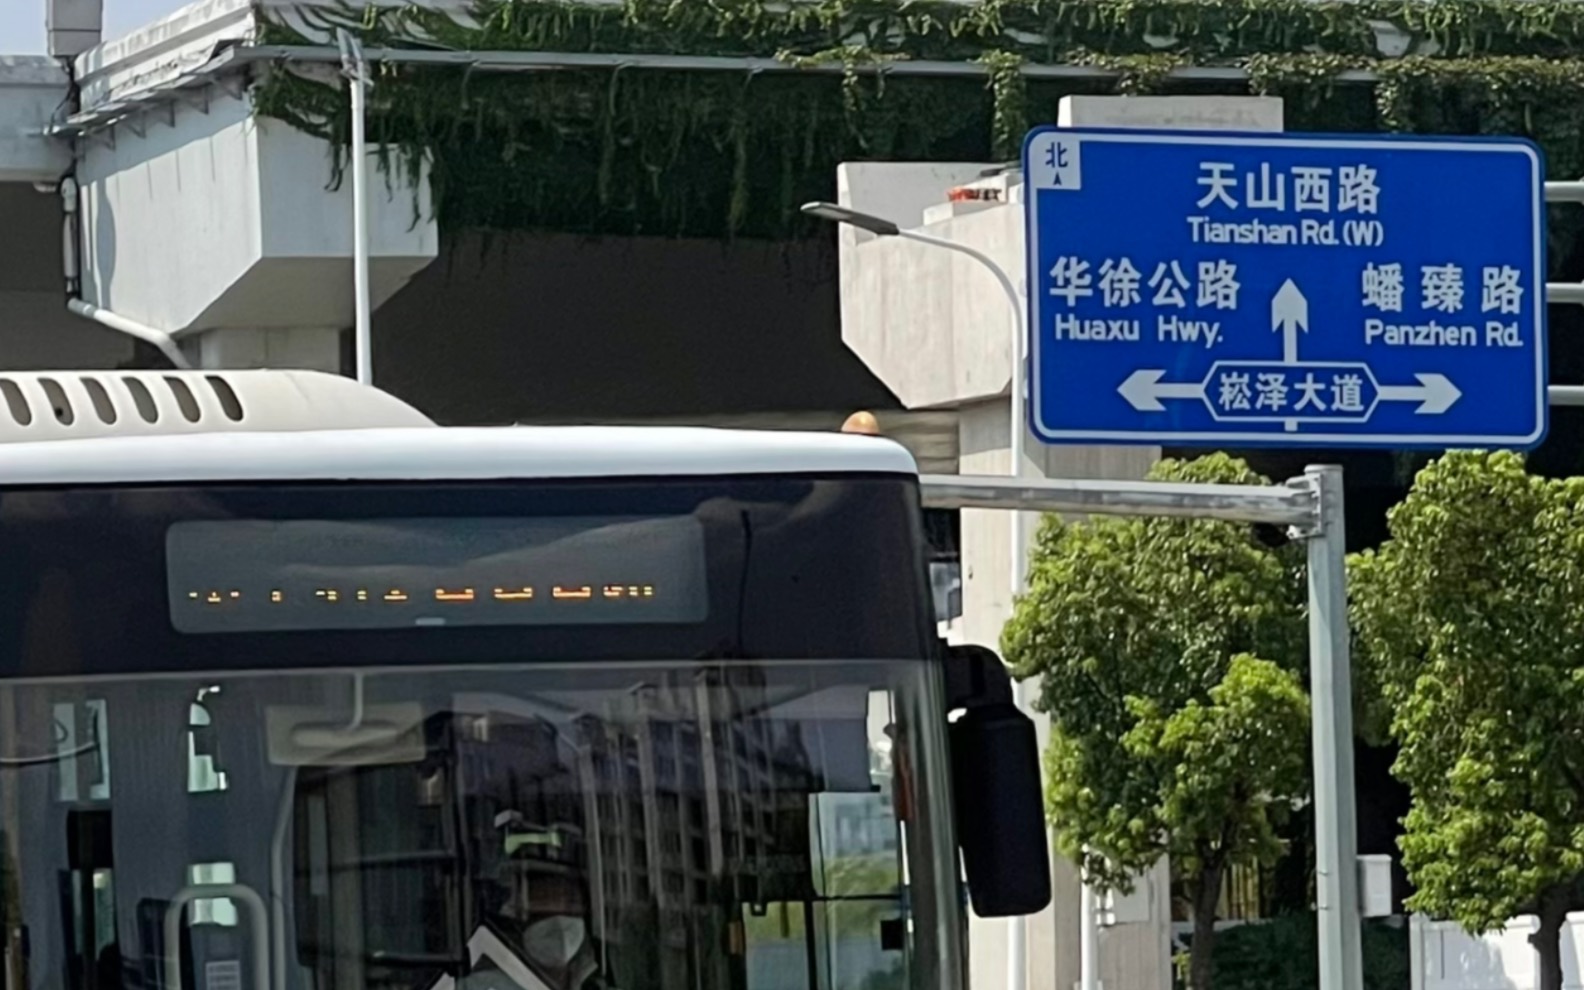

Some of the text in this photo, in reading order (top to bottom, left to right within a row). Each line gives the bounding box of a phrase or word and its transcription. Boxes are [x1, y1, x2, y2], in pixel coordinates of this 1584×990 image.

[1045, 141, 1068, 169] 北
[1196, 161, 1382, 215] 天山西路
[1187, 216, 1384, 247] Tianshan Rd. (W)
[1049, 255, 1242, 310] 华徐公路
[1054, 313, 1224, 349] Huaxu Hwy.
[1365, 318, 1525, 347] Panzhen Rd.
[1218, 372, 1365, 412] 崧泽大道
